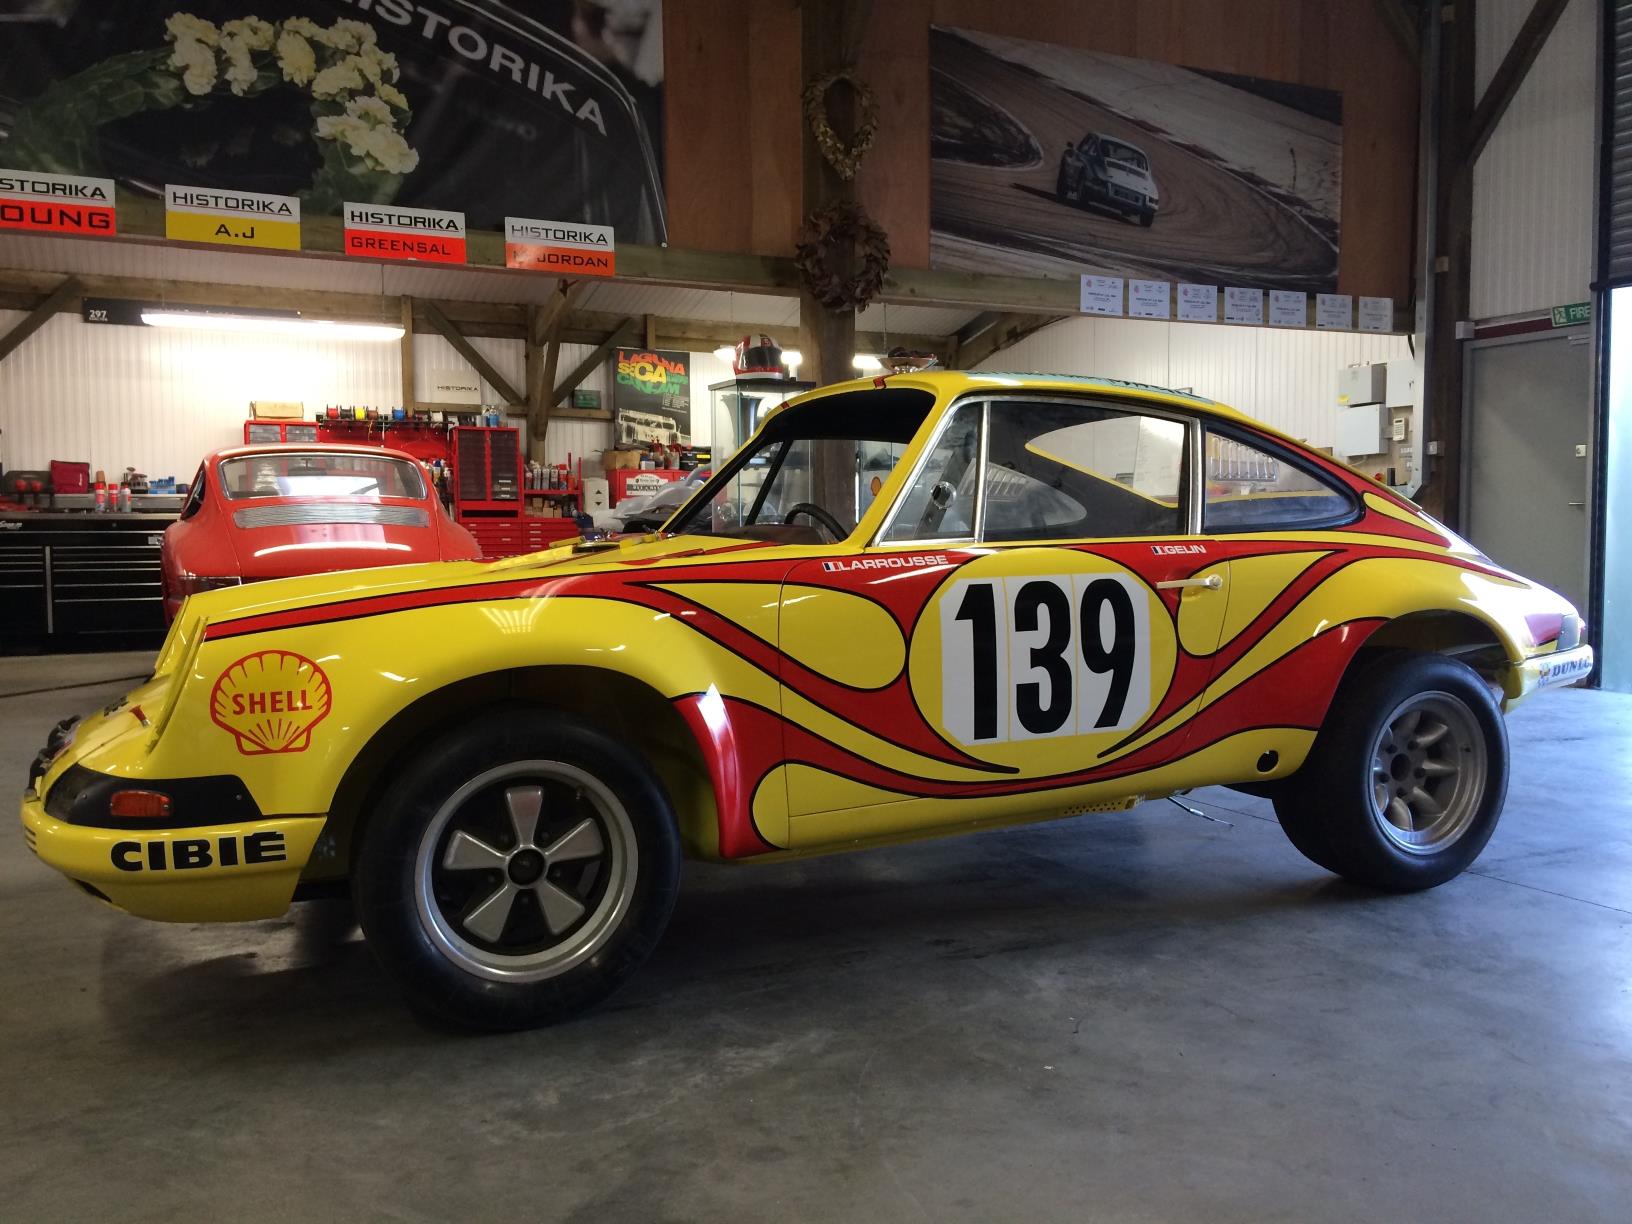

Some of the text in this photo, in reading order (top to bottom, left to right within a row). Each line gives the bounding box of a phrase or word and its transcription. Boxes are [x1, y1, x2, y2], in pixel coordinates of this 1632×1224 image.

[344, 0, 608, 136] STORIKA
[173, 192, 292, 215] HISTORIKA
[1, 205, 110, 230] OUNG
[351, 210, 459, 231] HISTORIKA
[215, 224, 255, 239] A.J
[512, 225, 608, 245] HISTORIKA
[351, 237, 451, 256] GREENSAL
[537, 253, 608, 268] JORDAN
[1569, 305, 1591, 320] FIRE
[1164, 544, 1207, 555] GELIN
[840, 555, 949, 571] LARROUSSE
[954, 578, 1136, 741] 139
[232, 689, 313, 716] SHELL
